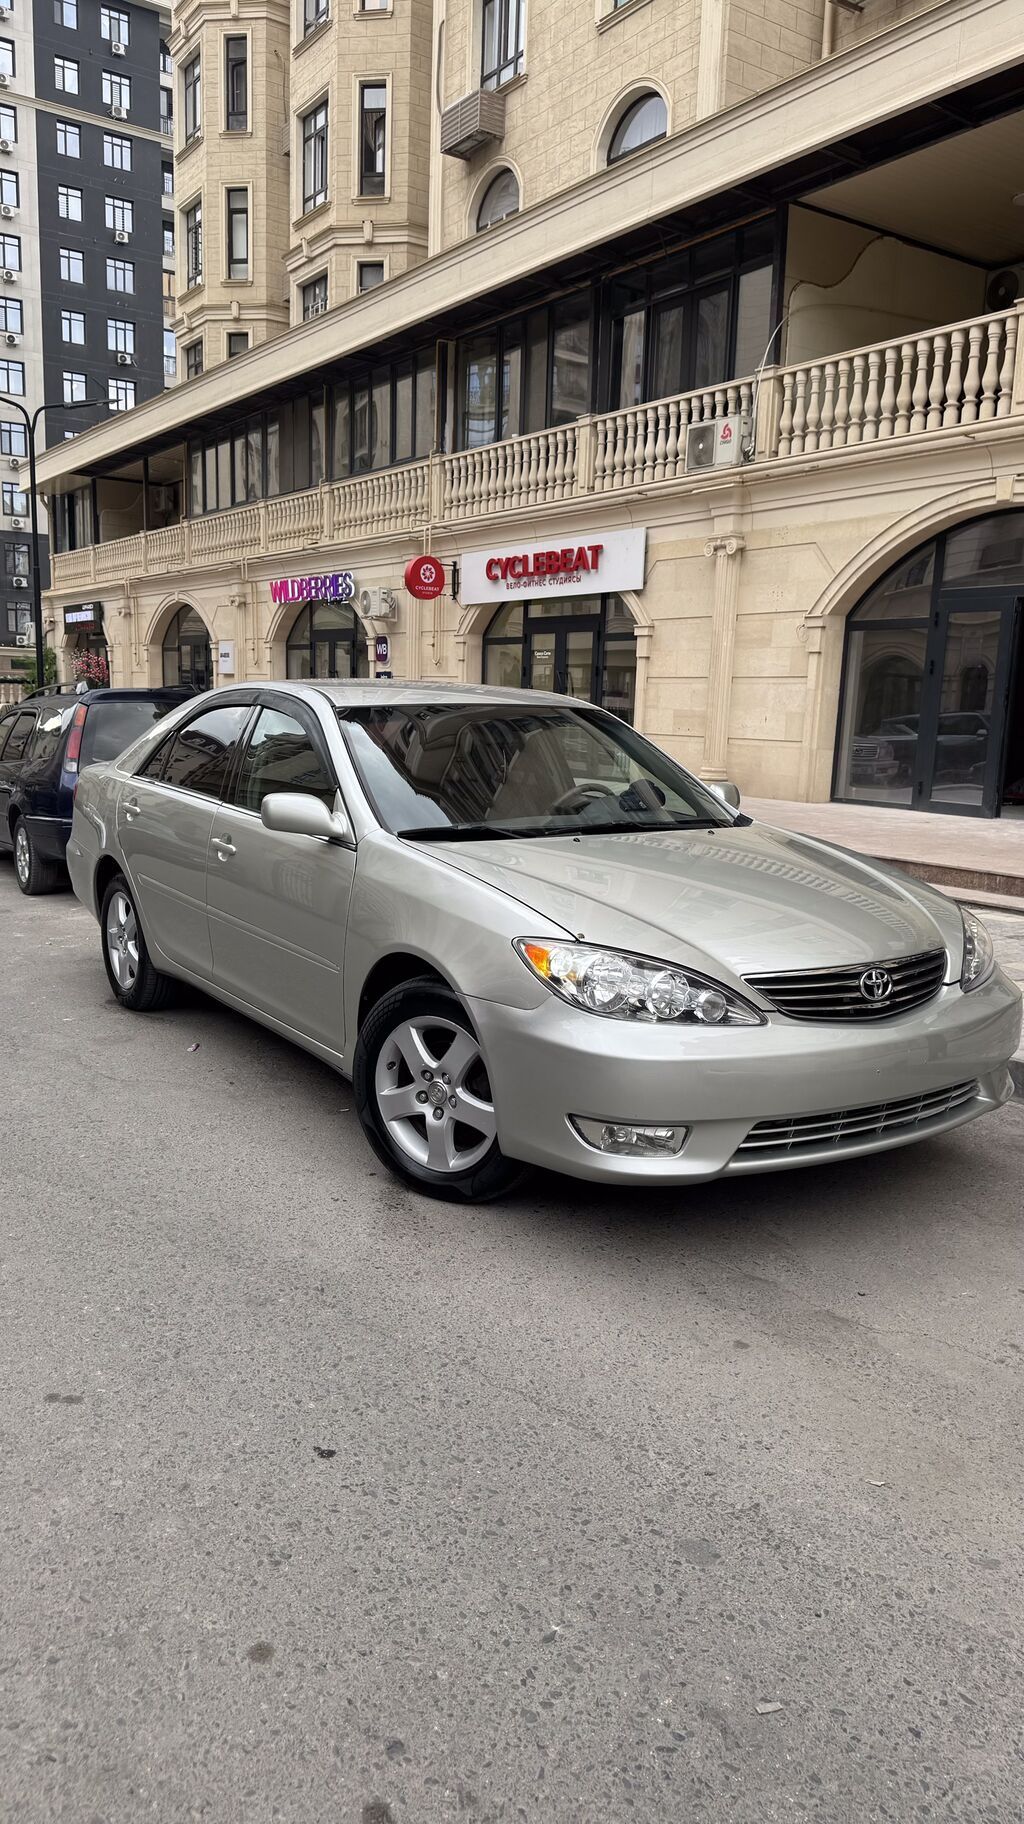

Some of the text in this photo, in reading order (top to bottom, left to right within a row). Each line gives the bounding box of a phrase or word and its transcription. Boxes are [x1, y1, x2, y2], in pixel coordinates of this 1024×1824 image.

[485, 544, 603, 581] CYCLEBEAT
[269, 571, 355, 603] WILDBERRIES
[506, 575, 582, 590] ВЕЛО-ФИТНЕС СТУДИЯСЫ
[376, 643, 387, 655] WB
